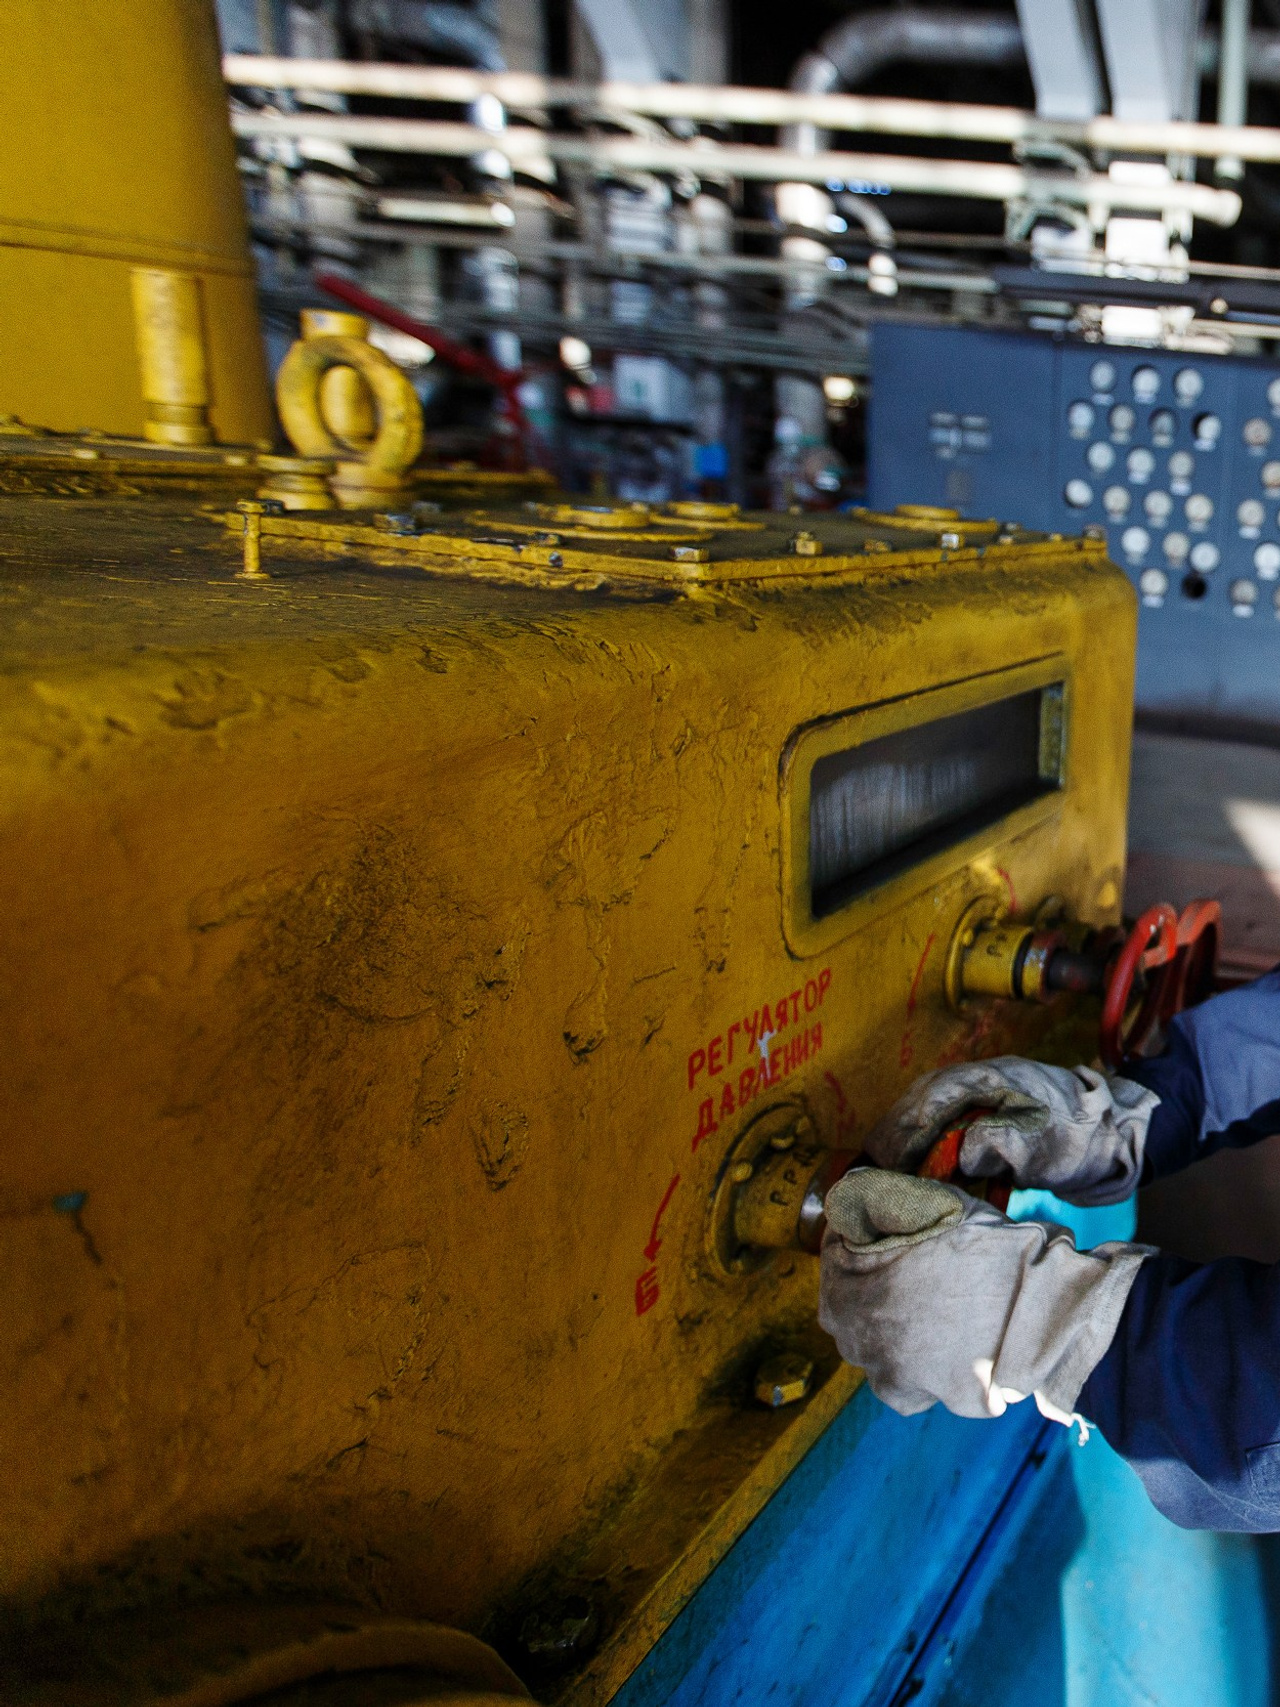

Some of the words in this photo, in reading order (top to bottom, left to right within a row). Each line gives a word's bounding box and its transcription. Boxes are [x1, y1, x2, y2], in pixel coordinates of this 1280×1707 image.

[688, 967, 832, 1091] РЕГУЛЯТОР
[691, 1021, 824, 1152] ДАВЛЕНИЯ
[635, 1265, 661, 1317] Б
